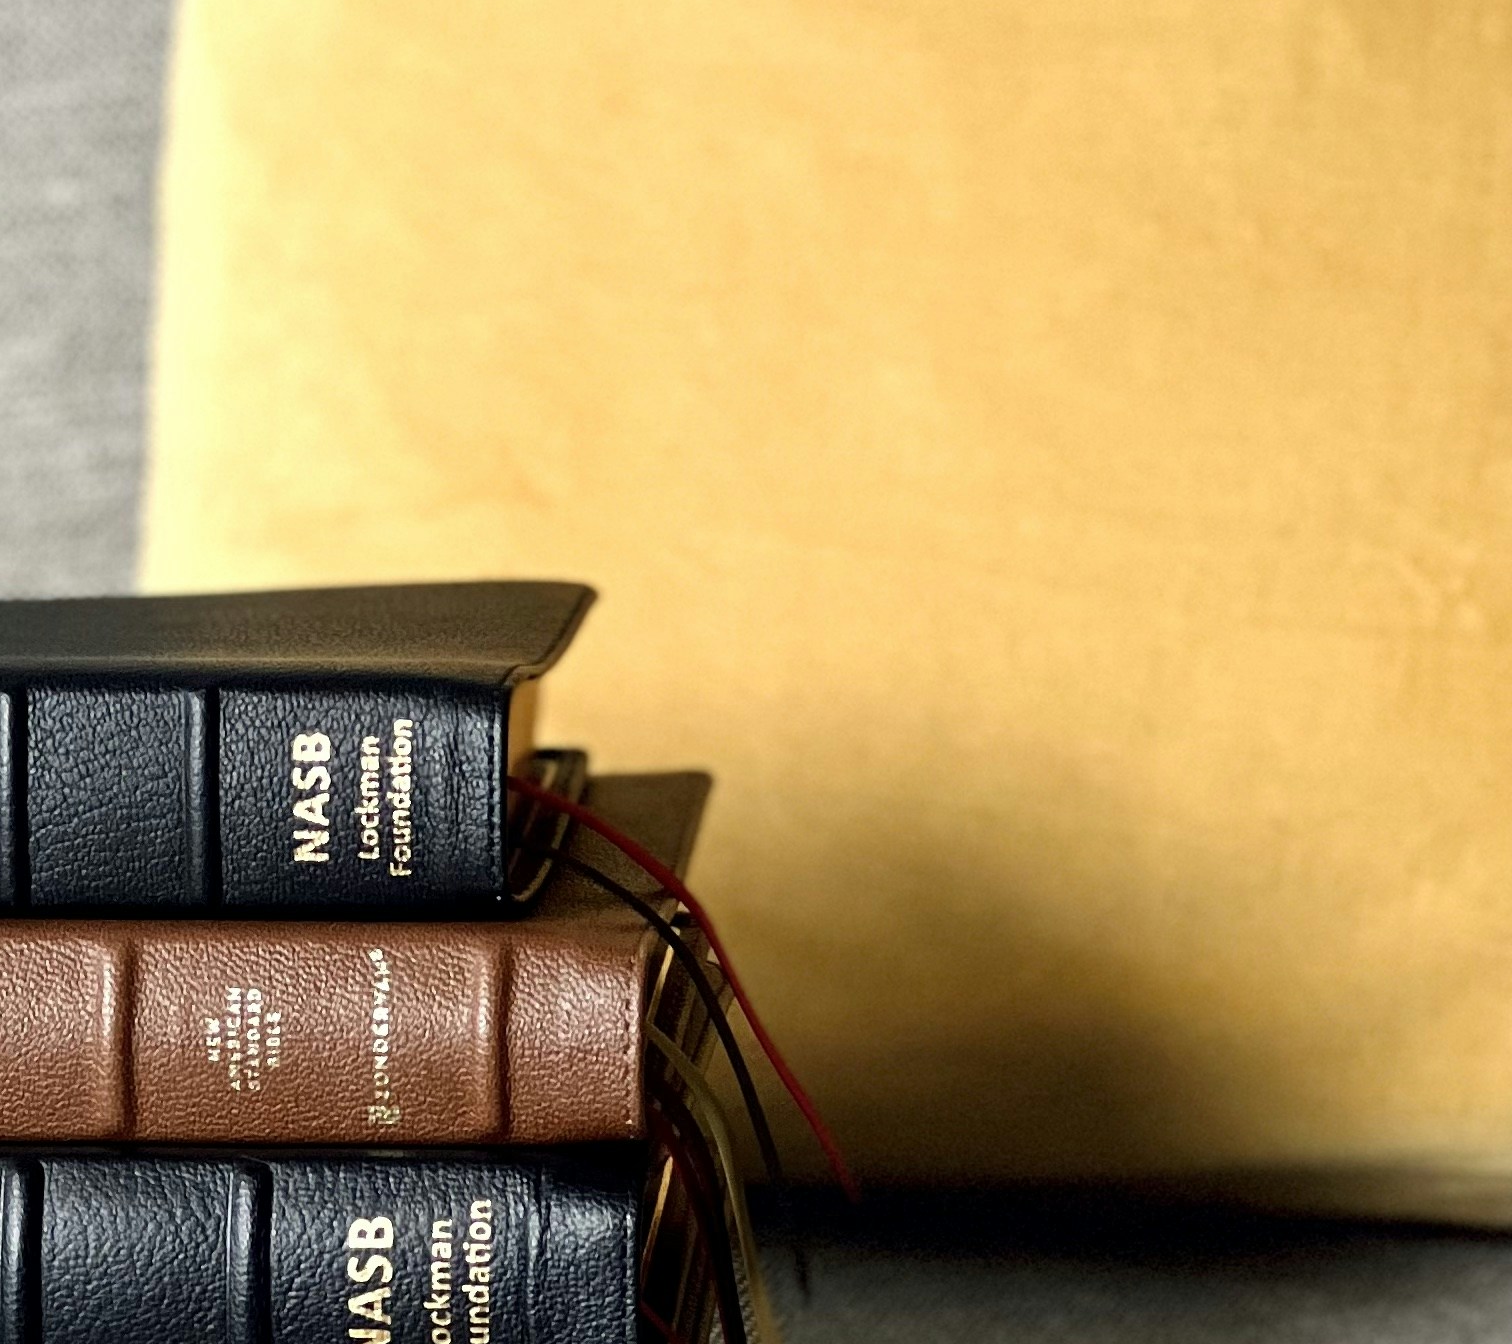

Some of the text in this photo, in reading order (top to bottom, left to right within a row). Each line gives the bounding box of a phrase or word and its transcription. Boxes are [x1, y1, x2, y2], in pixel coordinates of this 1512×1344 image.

[291, 731, 332, 864] NASB
[353, 734, 382, 861] Lockman
[386, 717, 413, 878] Foundation
[225, 986, 242, 1091] AMERICAN
[245, 987, 262, 1091] STANDARD
